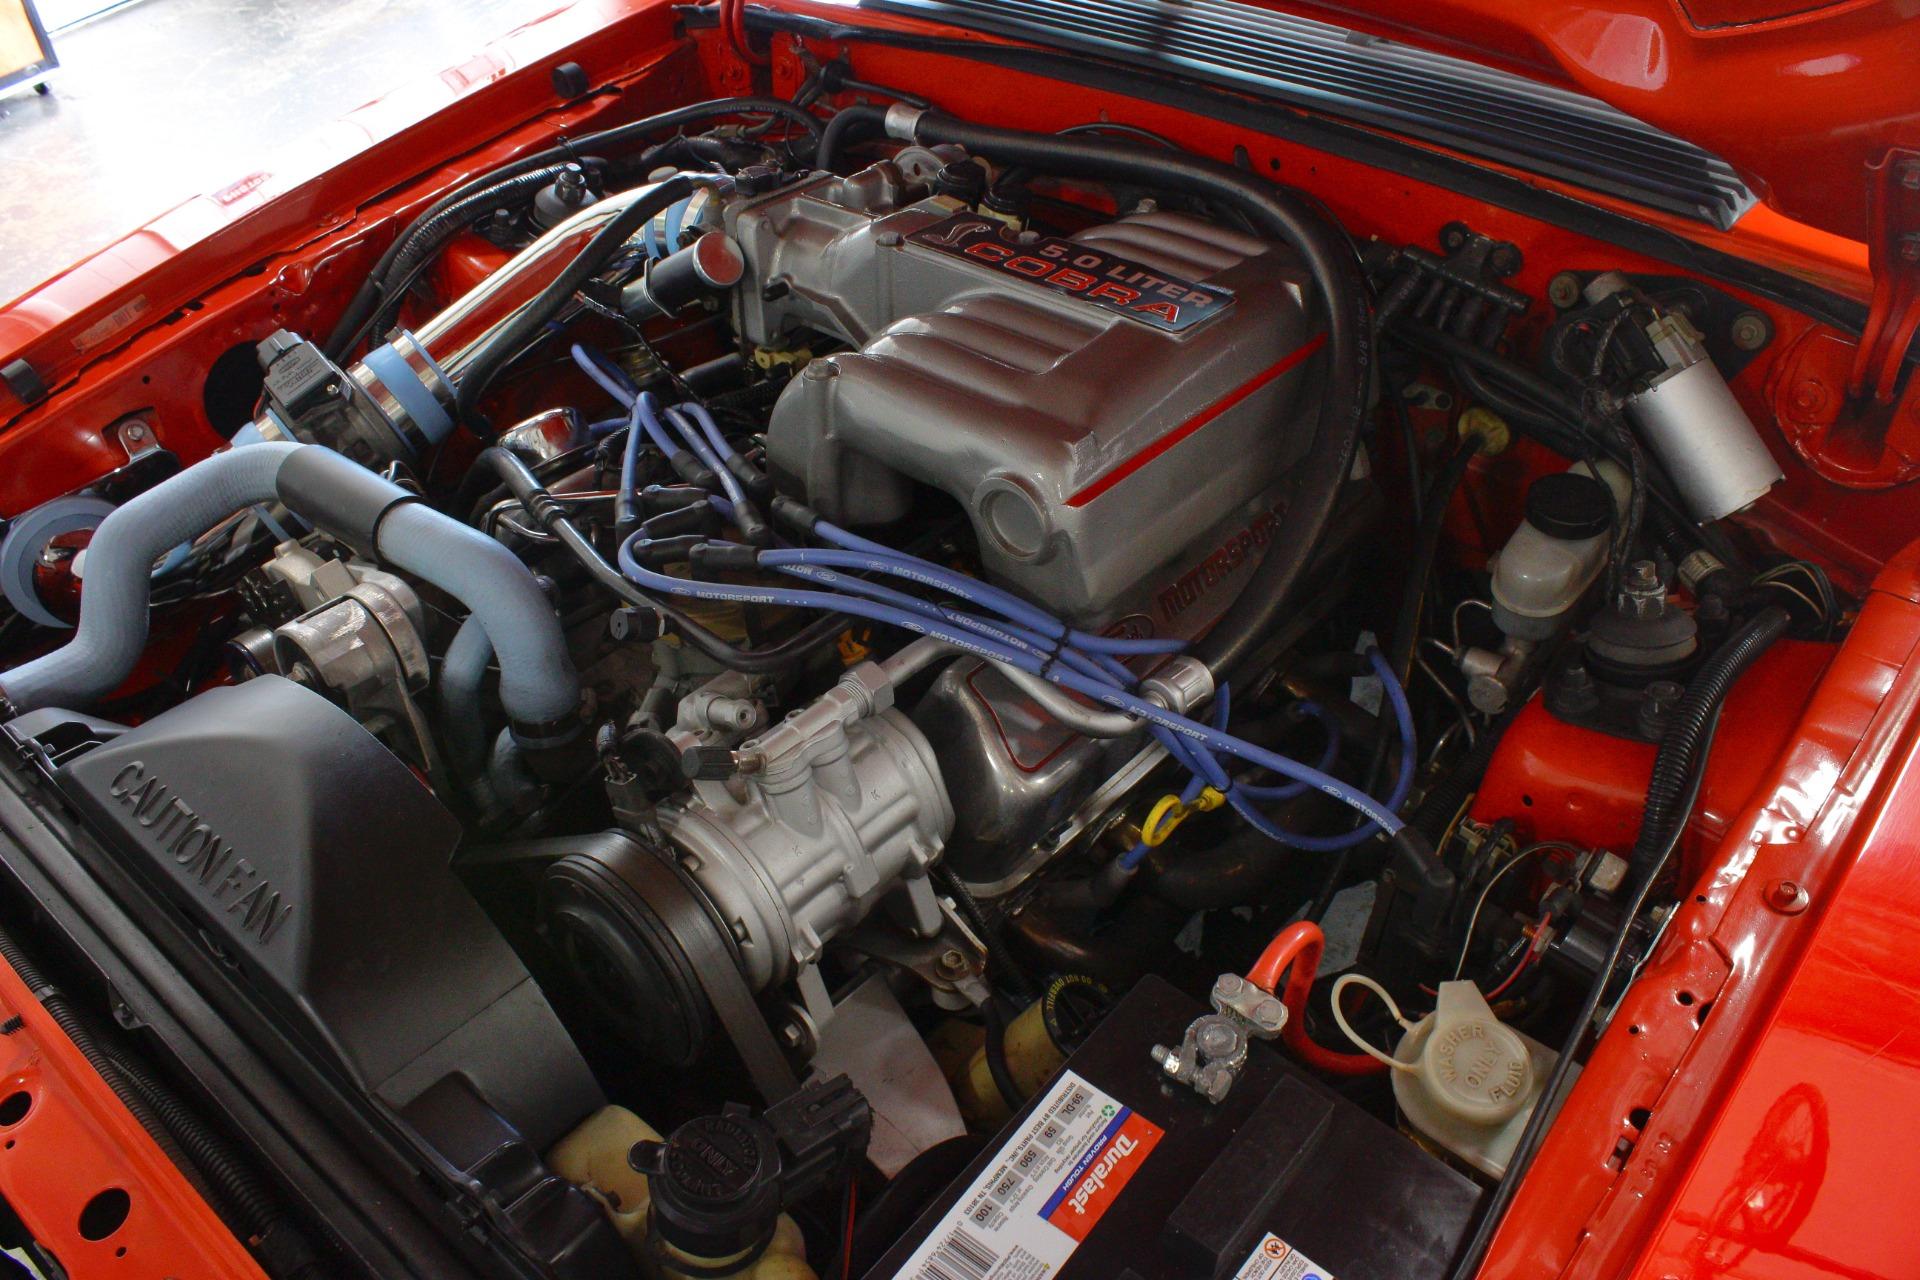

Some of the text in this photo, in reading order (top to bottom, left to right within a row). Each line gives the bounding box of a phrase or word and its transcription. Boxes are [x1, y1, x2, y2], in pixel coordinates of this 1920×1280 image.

[964, 242, 1181, 325] COBRA
[1039, 243, 1213, 308] 5.0 LITER
[696, 590, 775, 604] MOTORSPORT
[892, 566, 973, 600] MOTORSPORT
[930, 630, 1013, 664] MOTORSPORT
[948, 613, 1028, 650] MOTORSPORT
[1129, 705, 1208, 741] MOTORSPORT
[110, 760, 292, 944] CAUTION FAN
[1440, 1023, 1485, 1083] WASHER
[1465, 1040, 1503, 1088] ONLY
[1048, 1082, 1076, 1115] DISTRIBUTED
[1487, 1061, 1523, 1105] FLUID
[1062, 1093, 1083, 1115] 59-DL
[1031, 1121, 1044, 1136] BEST
[1044, 1126, 1056, 1139] 59
[1020, 1150, 1036, 1168] 590
[1063, 1135, 1107, 1191] PROVEN TOUGH
[1068, 1134, 1139, 1215] Duralast
[984, 1165, 1007, 1190] MEMPHIS,
[997, 1178, 1015, 1196] 750
[976, 1205, 992, 1222] 100
